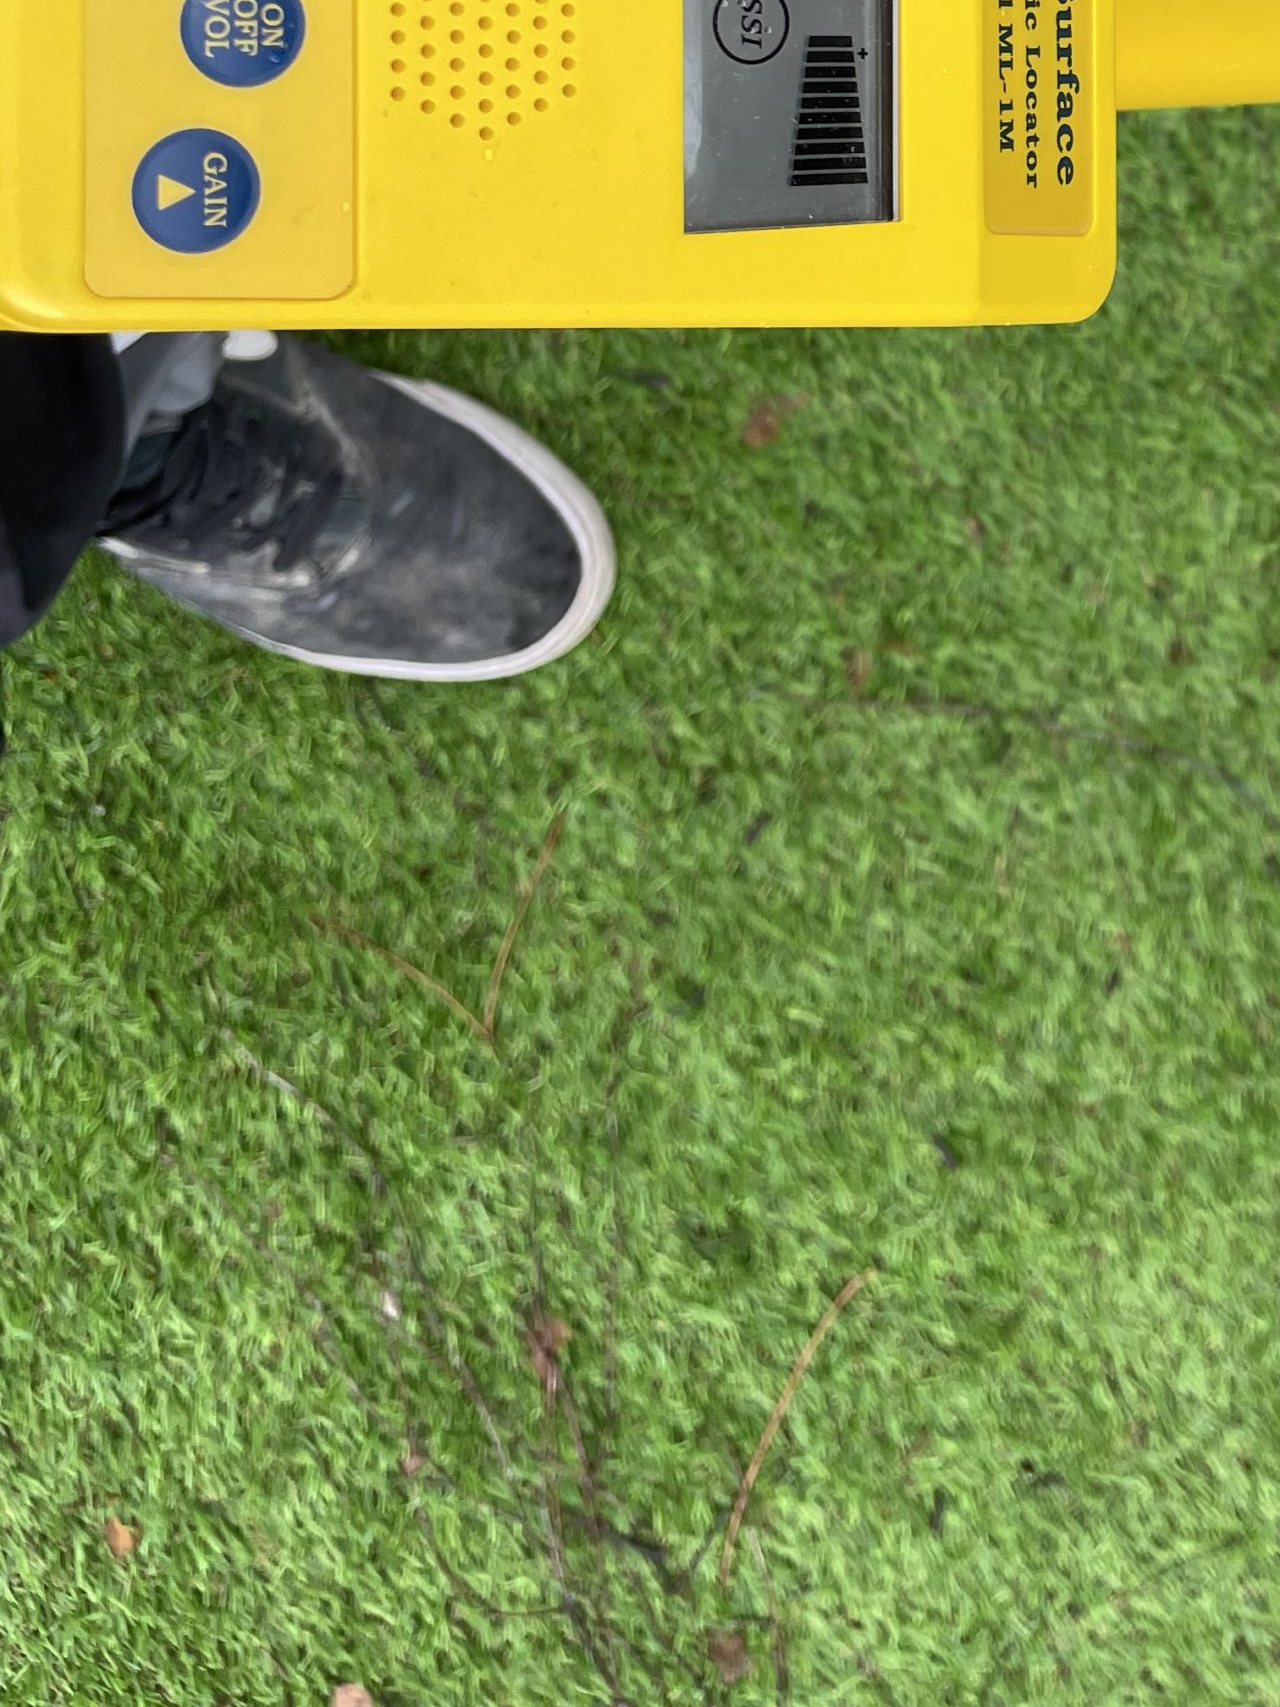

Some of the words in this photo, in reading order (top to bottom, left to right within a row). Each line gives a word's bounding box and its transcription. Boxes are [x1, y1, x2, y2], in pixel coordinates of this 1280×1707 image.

[260, 3, 285, 48] ON
[999, 23, 1015, 152] ML-1M
[1025, 46, 1042, 189] Locator
[202, 151, 228, 227] GAIN
